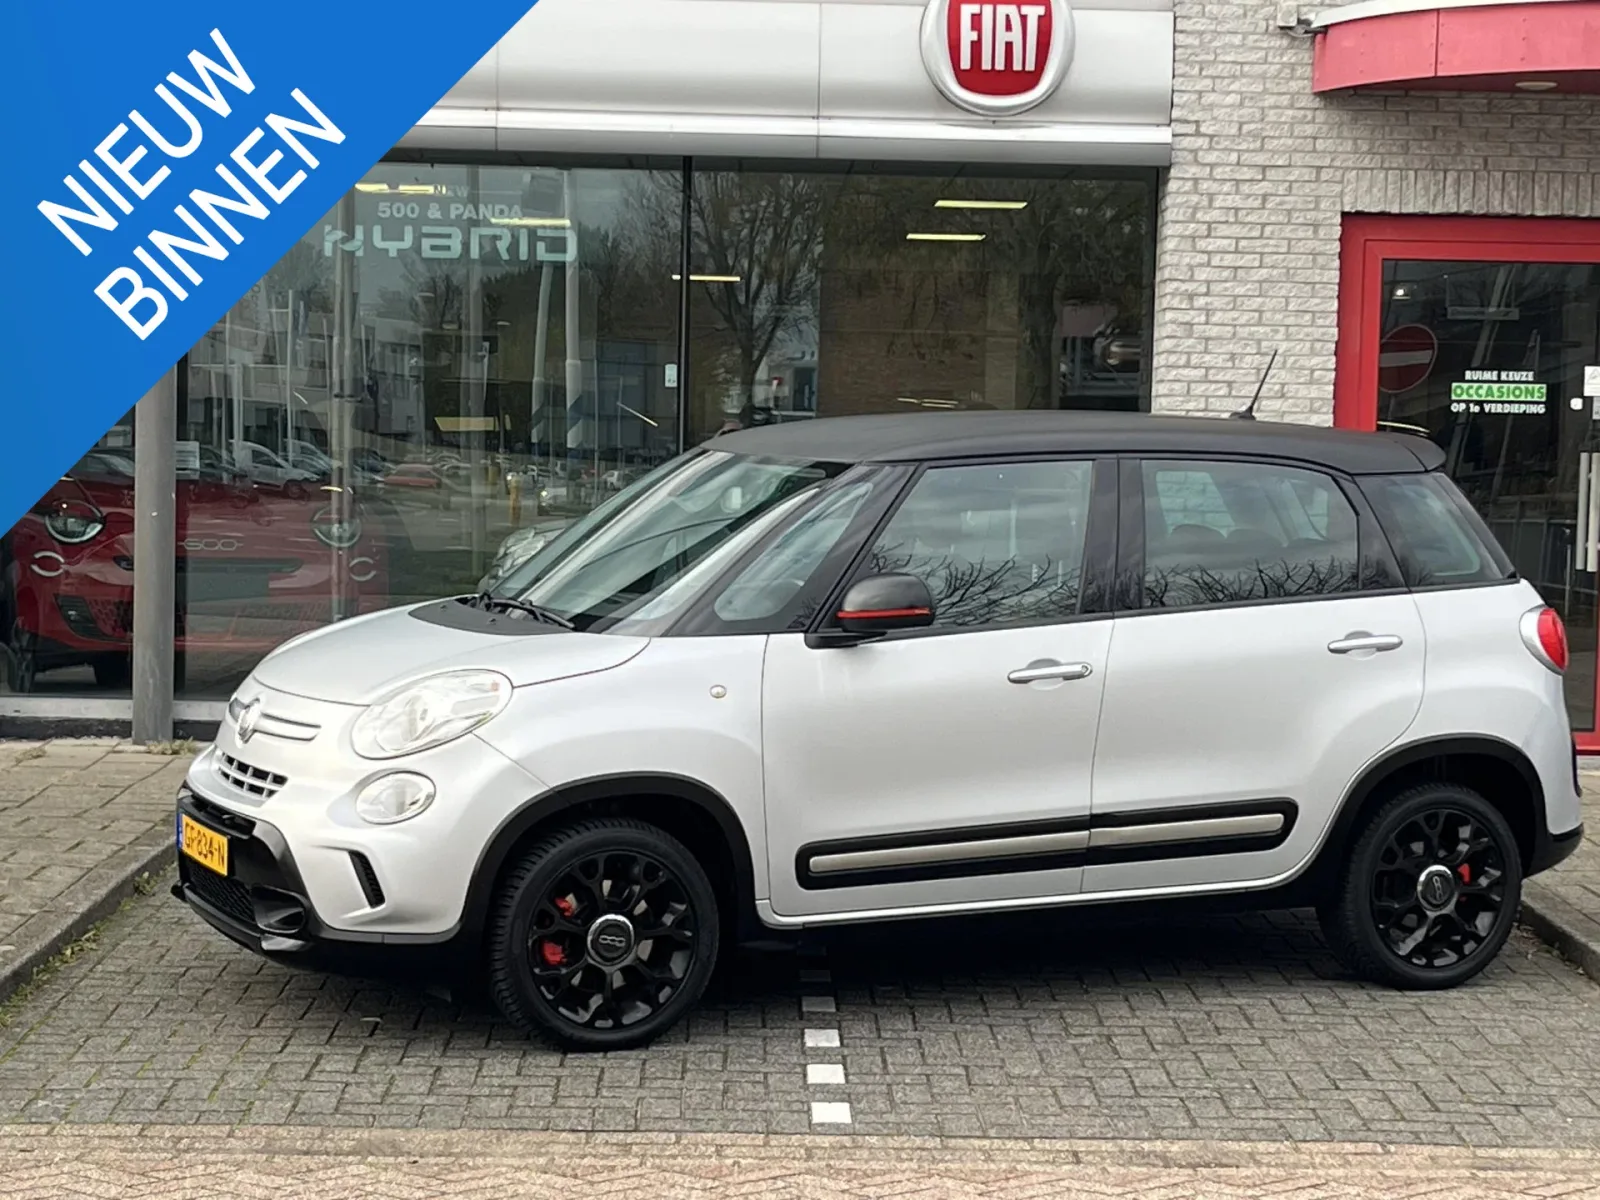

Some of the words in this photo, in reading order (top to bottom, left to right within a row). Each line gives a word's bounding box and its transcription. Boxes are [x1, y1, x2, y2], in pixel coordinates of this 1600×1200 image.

[960, 4, 1046, 71] FIAT
[377, 202, 419, 218] 500
[427, 202, 442, 219] &
[449, 203, 523, 220] PANDA
[323, 223, 578, 262] HYBRID
[1465, 370, 1498, 380] RUIME
[1501, 371, 1534, 381] KEUZE
[1452, 384, 1545, 399] OCCASIONS
[1451, 402, 1466, 412] OP
[1483, 403, 1546, 414] VERDIEPING
[184, 539, 237, 550] 500
[185, 822, 225, 869] GF-834-N
